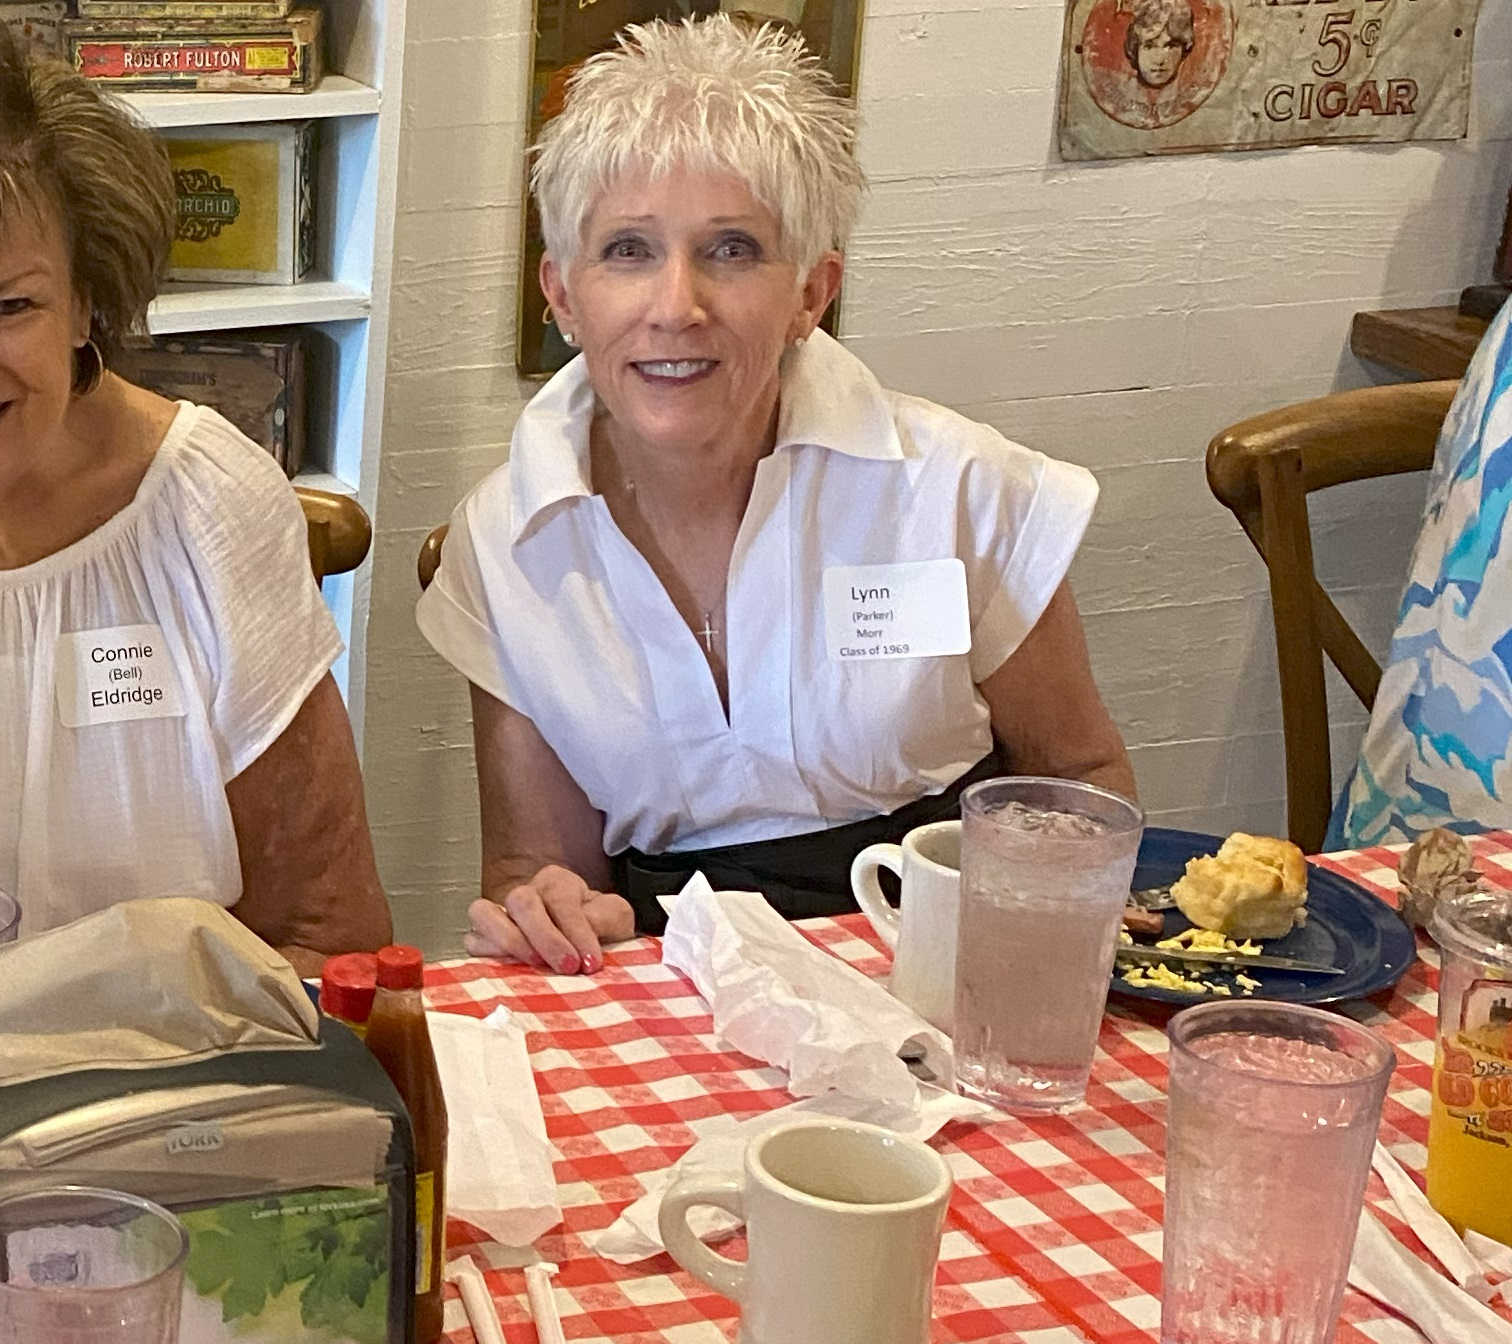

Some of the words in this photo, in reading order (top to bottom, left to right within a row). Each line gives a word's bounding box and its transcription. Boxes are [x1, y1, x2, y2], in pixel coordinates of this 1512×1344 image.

[1312, 9, 1382, 77] 5¢
[124, 51, 180, 70] ROBERT
[185, 51, 240, 68] FULTON
[1264, 78, 1419, 122] CIGAR
[851, 586, 890, 603] Lynn
[852, 610, 894, 623] (Parker)
[91, 643, 153, 663] Connie
[840, 646, 866, 657] Class
[869, 644, 880, 655] of
[883, 643, 910, 654] 1969
[108, 666, 143, 683] (Bell)
[91, 686, 163, 707] Eldridge
